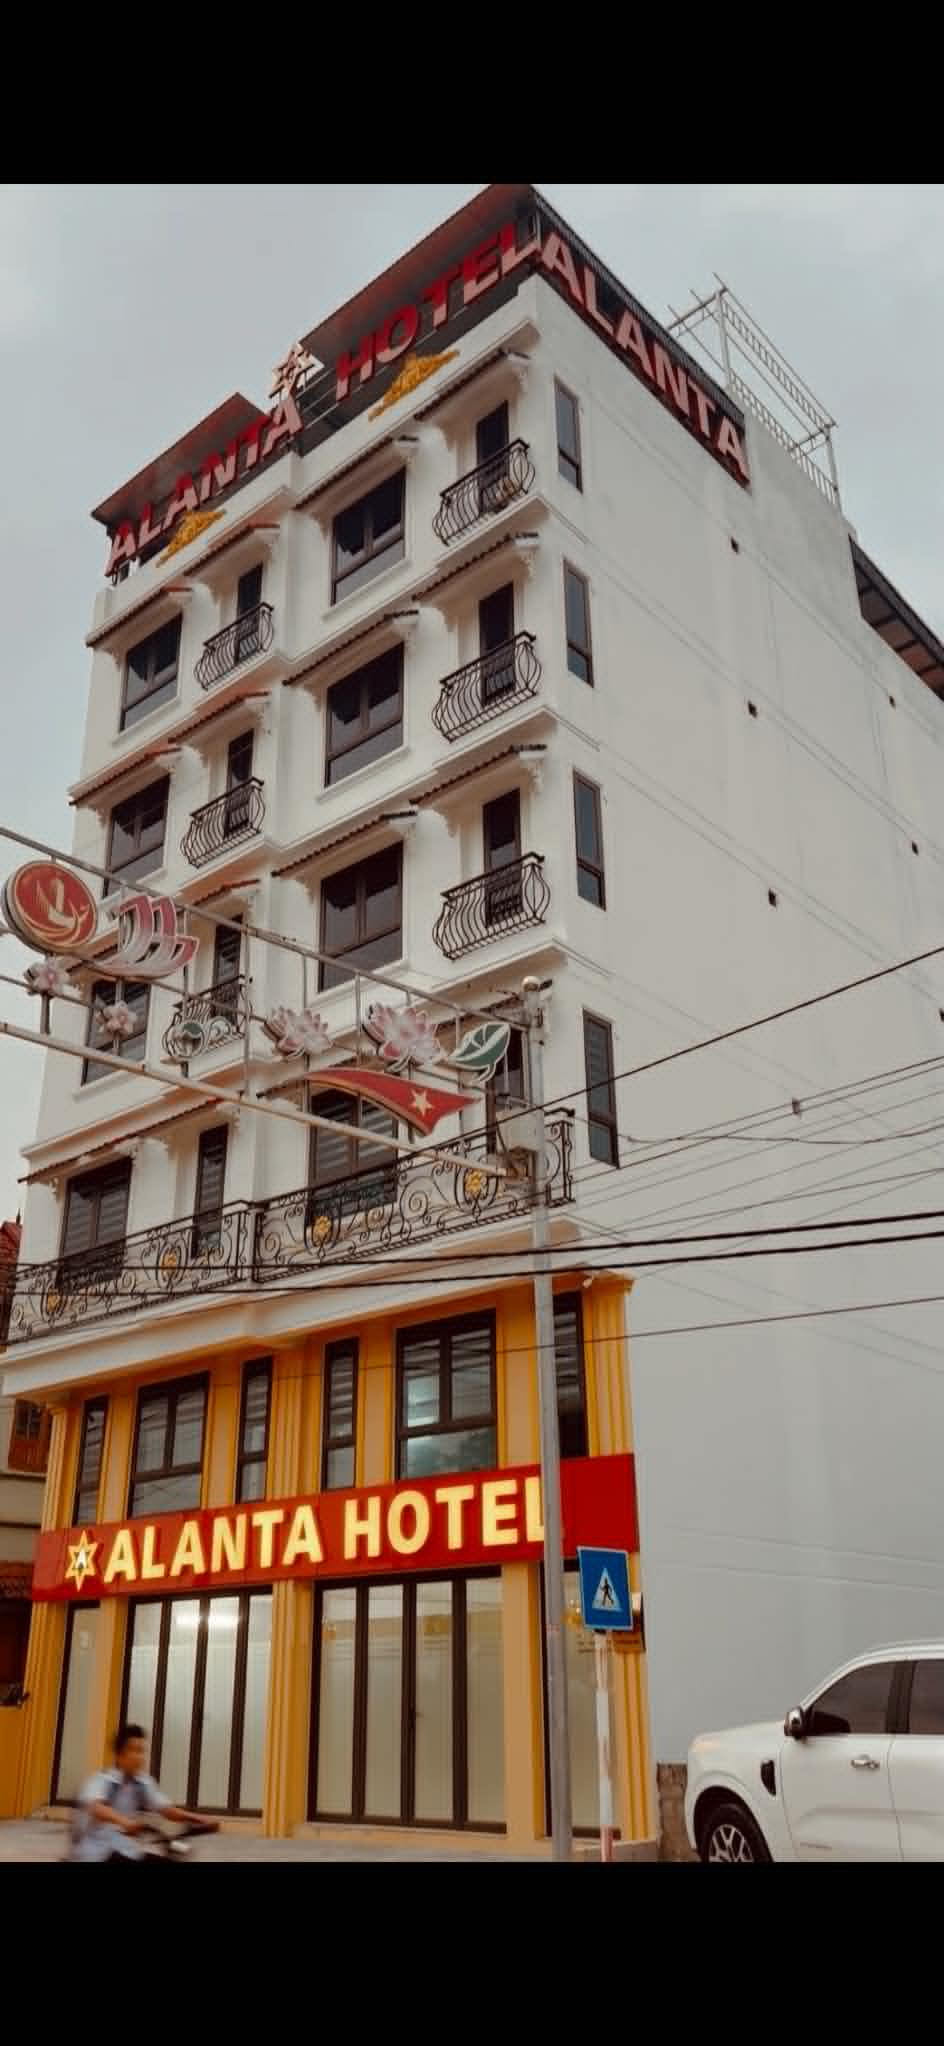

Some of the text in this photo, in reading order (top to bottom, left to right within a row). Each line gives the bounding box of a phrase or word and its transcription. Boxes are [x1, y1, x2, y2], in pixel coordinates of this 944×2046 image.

[104, 223, 541, 577] ALANTA HOTEL
[541, 231, 751, 489] ALANTA
[103, 1476, 545, 1584] ALANTA HOTEL
